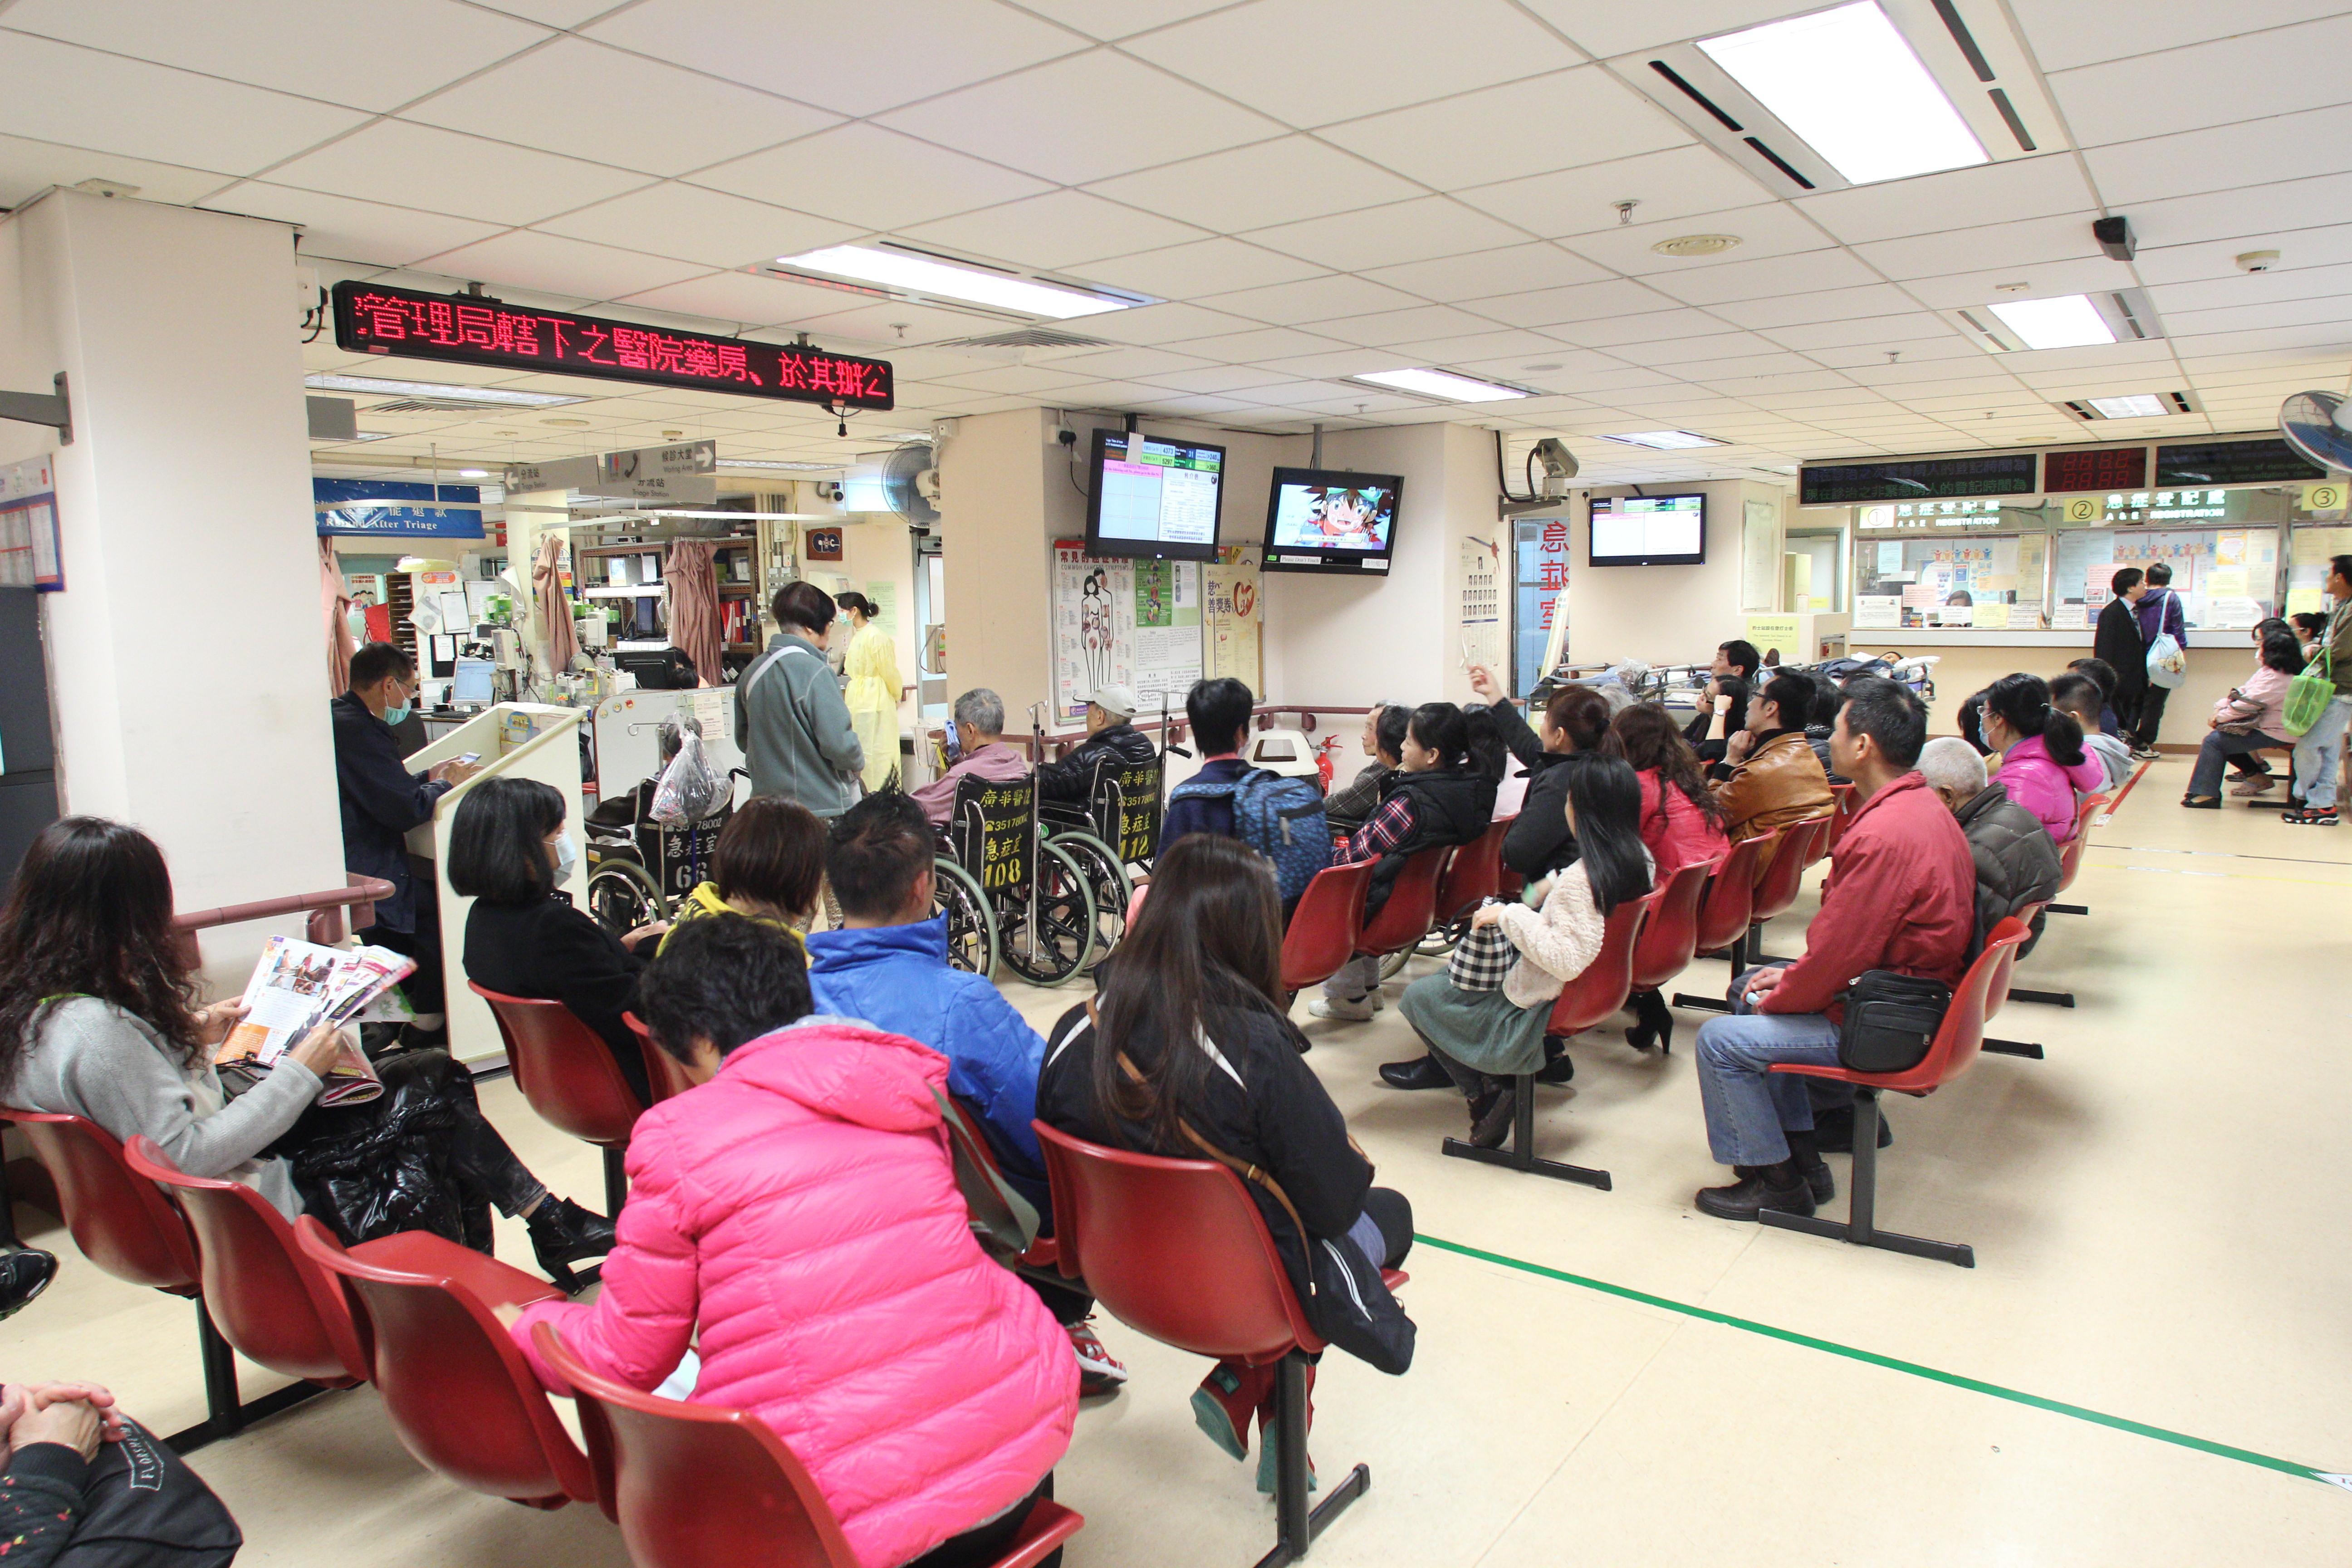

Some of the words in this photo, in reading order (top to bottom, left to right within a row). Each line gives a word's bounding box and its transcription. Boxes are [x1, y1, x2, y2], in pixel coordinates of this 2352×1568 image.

[354, 293, 887, 399] 管理局轄下之醫院藥房、於其辦公
[521, 468, 540, 480] 分流站
[632, 489, 650, 497] Triage
[2107, 490, 2225, 509] 急症登記處
[1898, 501, 2000, 517] 急症登記處
[2106, 512, 2114, 521] A
[2119, 512, 2127, 520] &
[2131, 511, 2139, 520] E
[2150, 509, 2225, 519] REGISTRATION
[373, 519, 399, 529] After
[405, 520, 438, 530] Triage
[1936, 517, 1999, 526] REGISTRATION
[1118, 769, 1159, 788] 廣華醫院
[980, 787, 1032, 808] 廣華醫院
[1121, 812, 1151, 835] 急症室
[985, 833, 1022, 862] 急症室
[1119, 834, 1148, 860] 112
[984, 858, 1021, 887] 108
